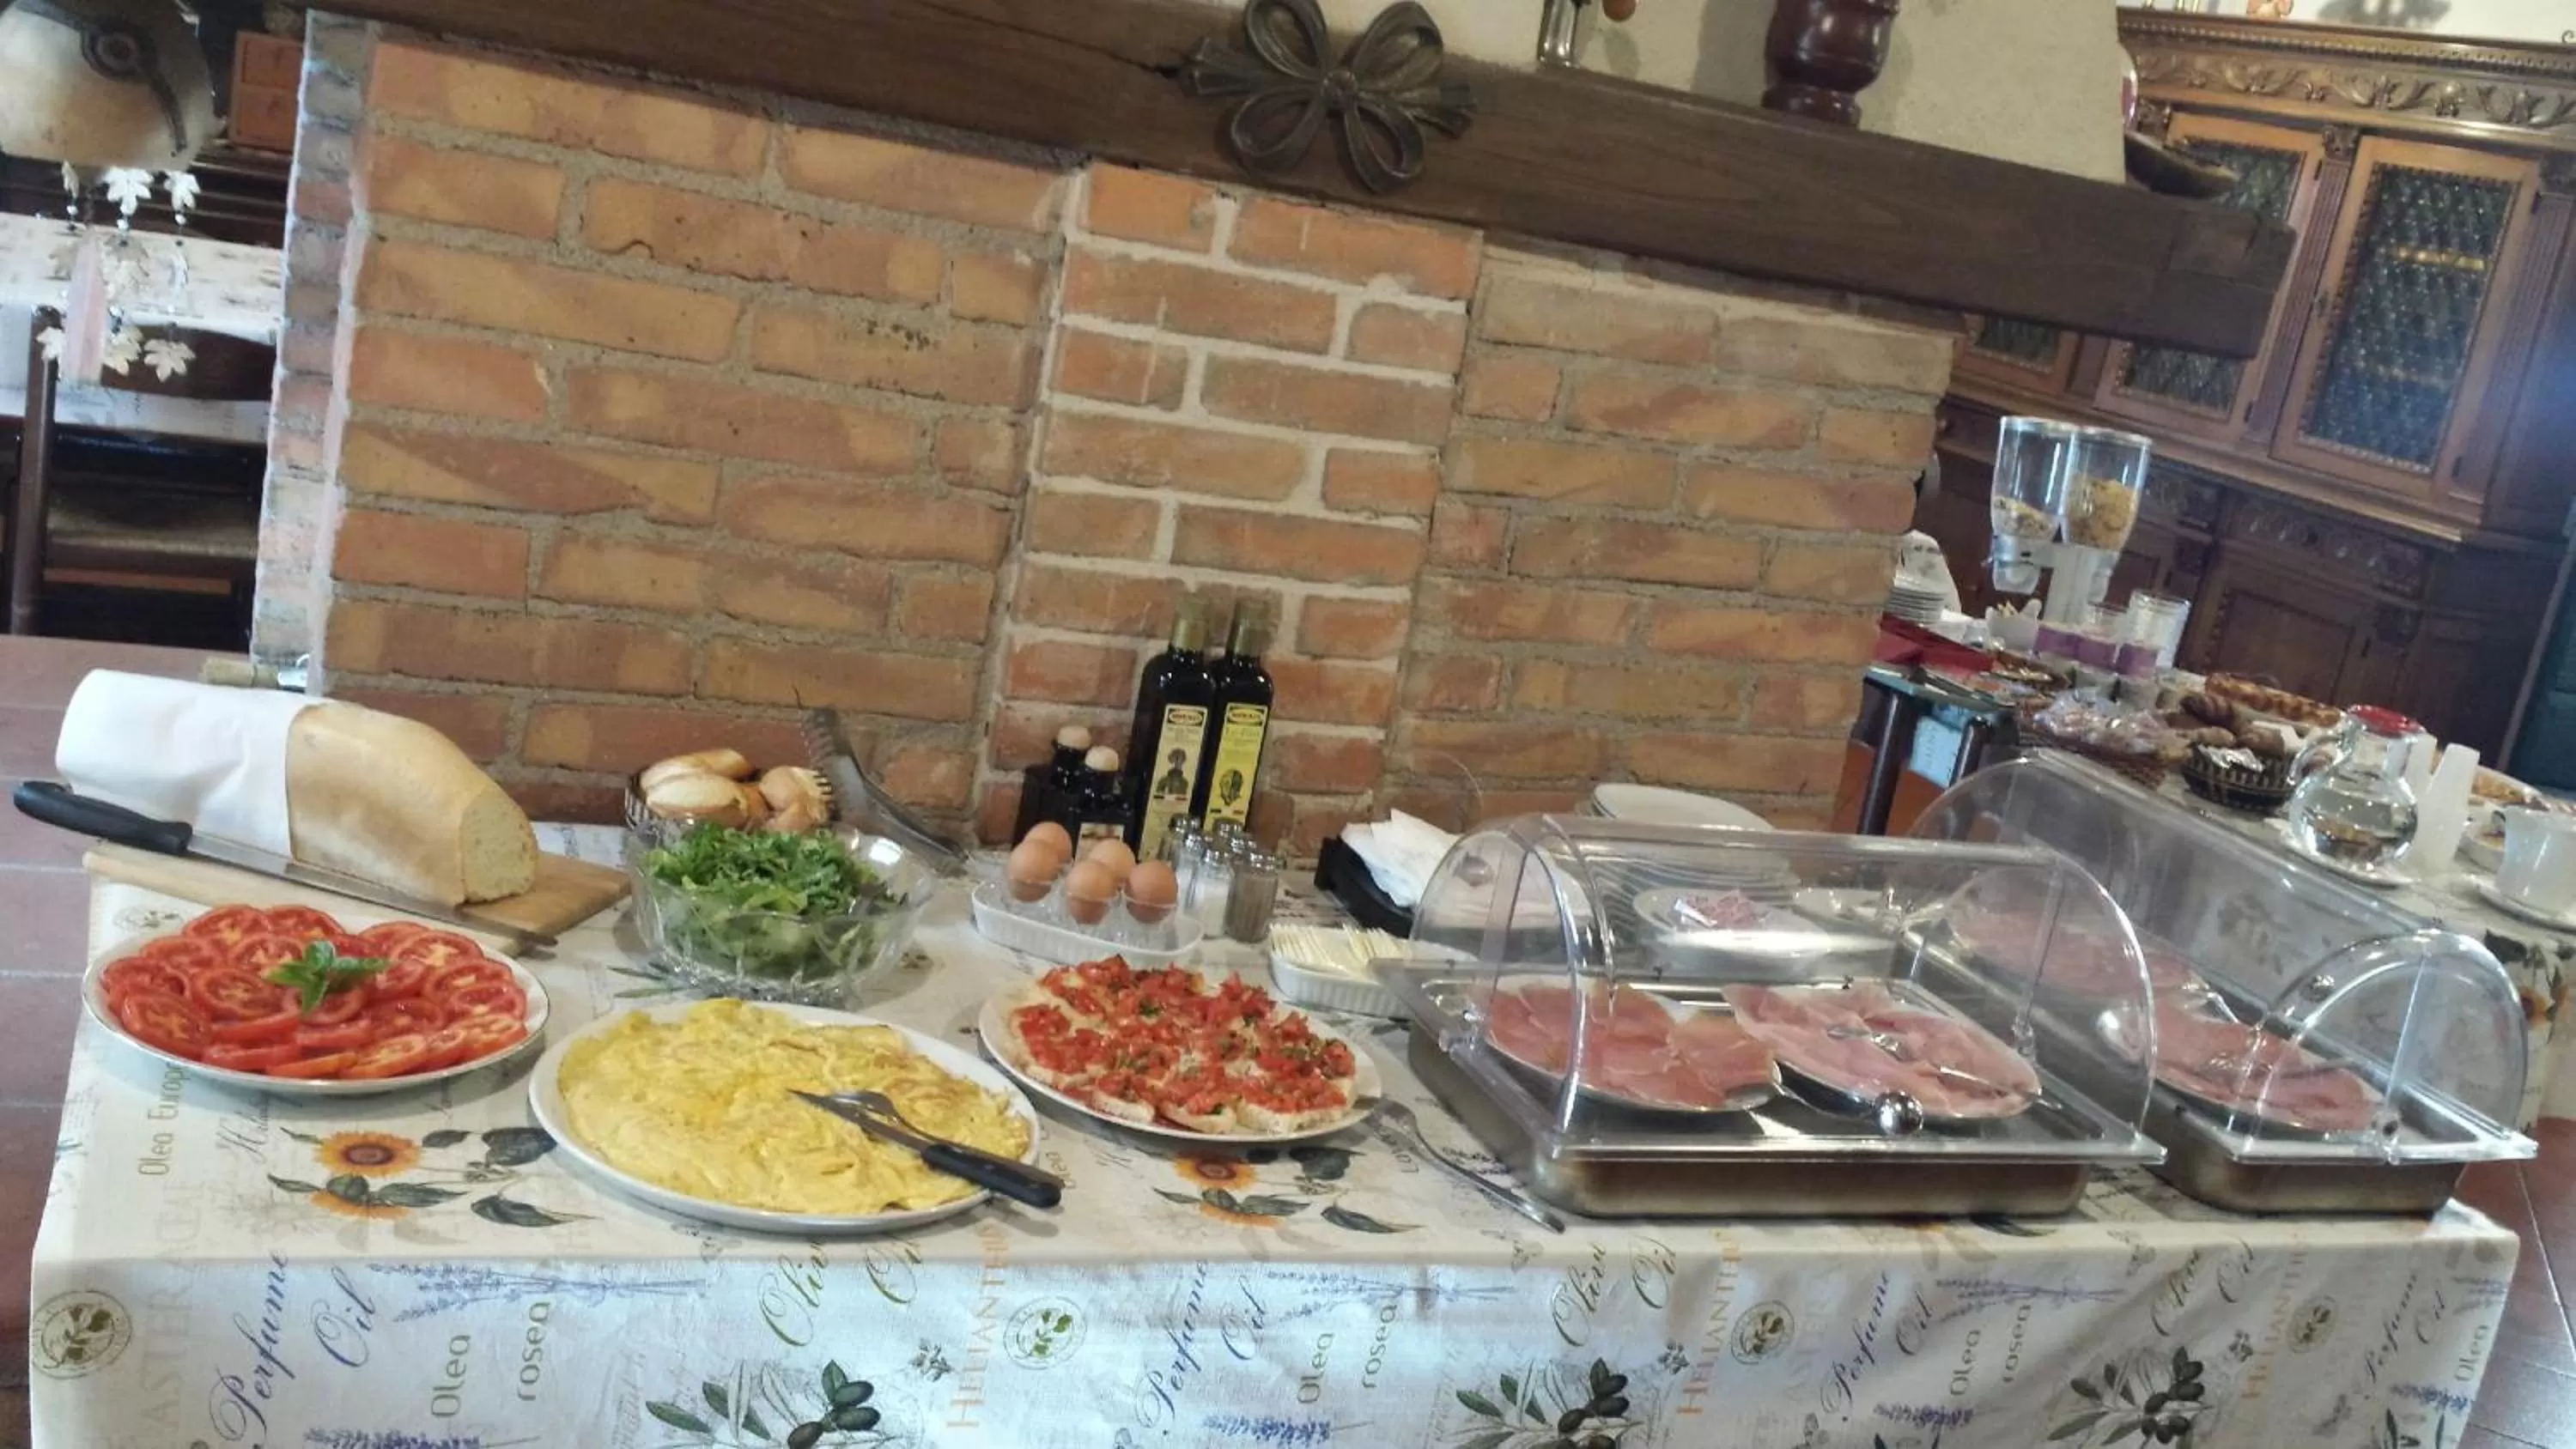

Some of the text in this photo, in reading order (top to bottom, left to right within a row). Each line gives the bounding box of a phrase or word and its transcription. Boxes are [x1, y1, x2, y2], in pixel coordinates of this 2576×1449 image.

[147, 1061, 191, 1120] Europ
[210, 1248, 296, 1443] Perfume
[311, 1264, 376, 1368] Oil
[515, 1300, 551, 1403] rosea
[1134, 1260, 1207, 1429] Perfume
[1219, 1274, 1267, 1361] Oil
[1362, 1303, 1399, 1390] rosea
[2003, 1303, 2032, 1383] rosea
[431, 1333, 471, 1420] Olea
[1296, 1332, 1334, 1405] Olea
[1950, 1329, 1982, 1397] Olea
